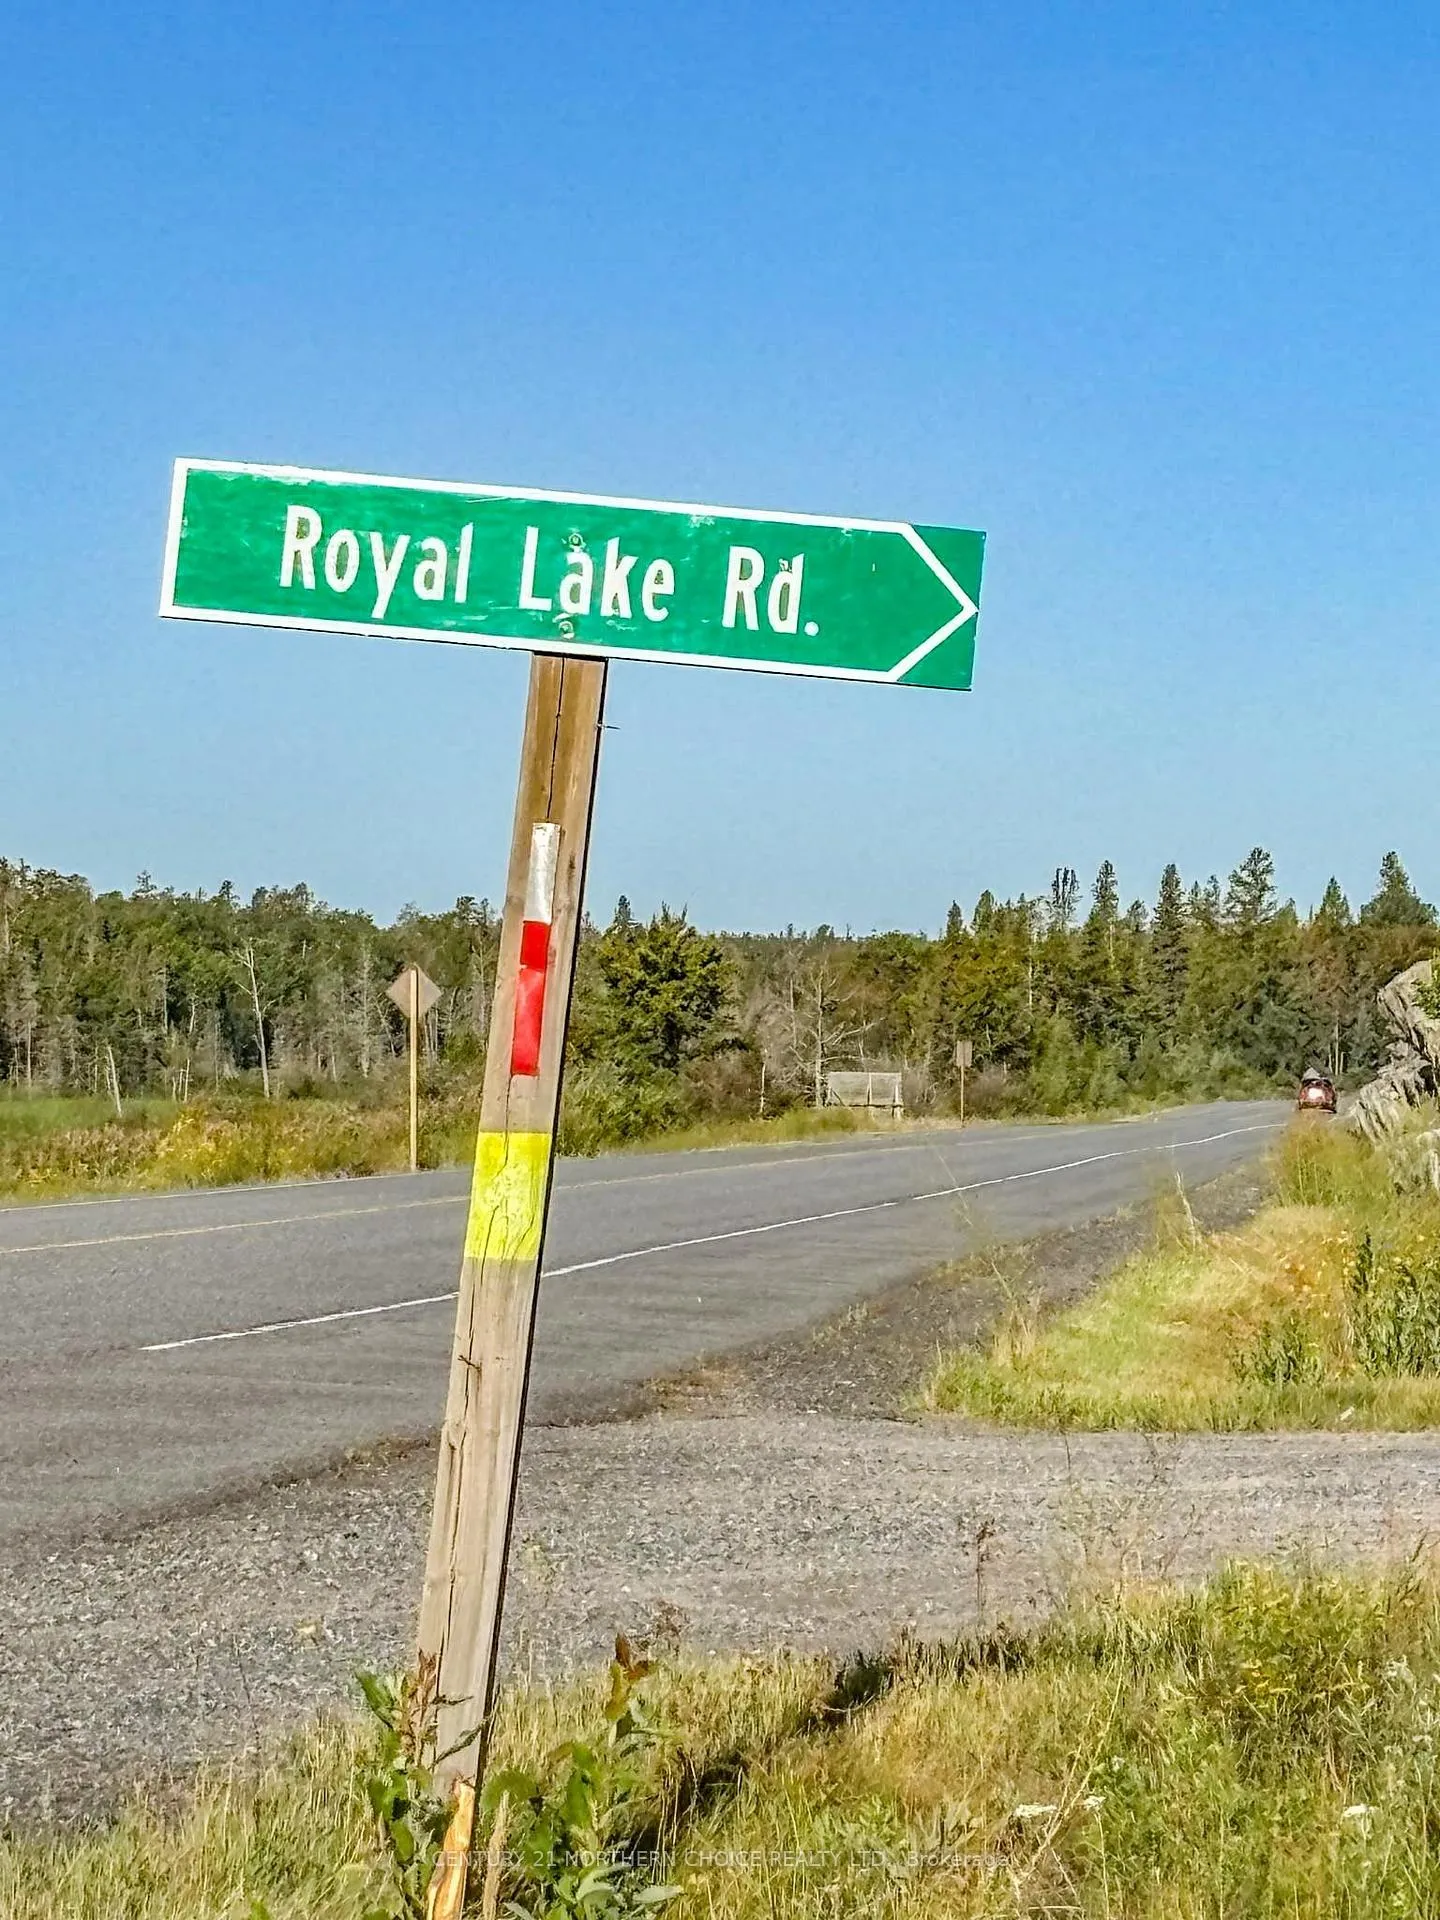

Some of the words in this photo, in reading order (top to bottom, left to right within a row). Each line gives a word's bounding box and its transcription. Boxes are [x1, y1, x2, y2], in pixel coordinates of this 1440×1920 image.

[278, 504, 473, 620] Royal
[519, 525, 677, 622] Lake
[721, 546, 820, 636] Rd.
